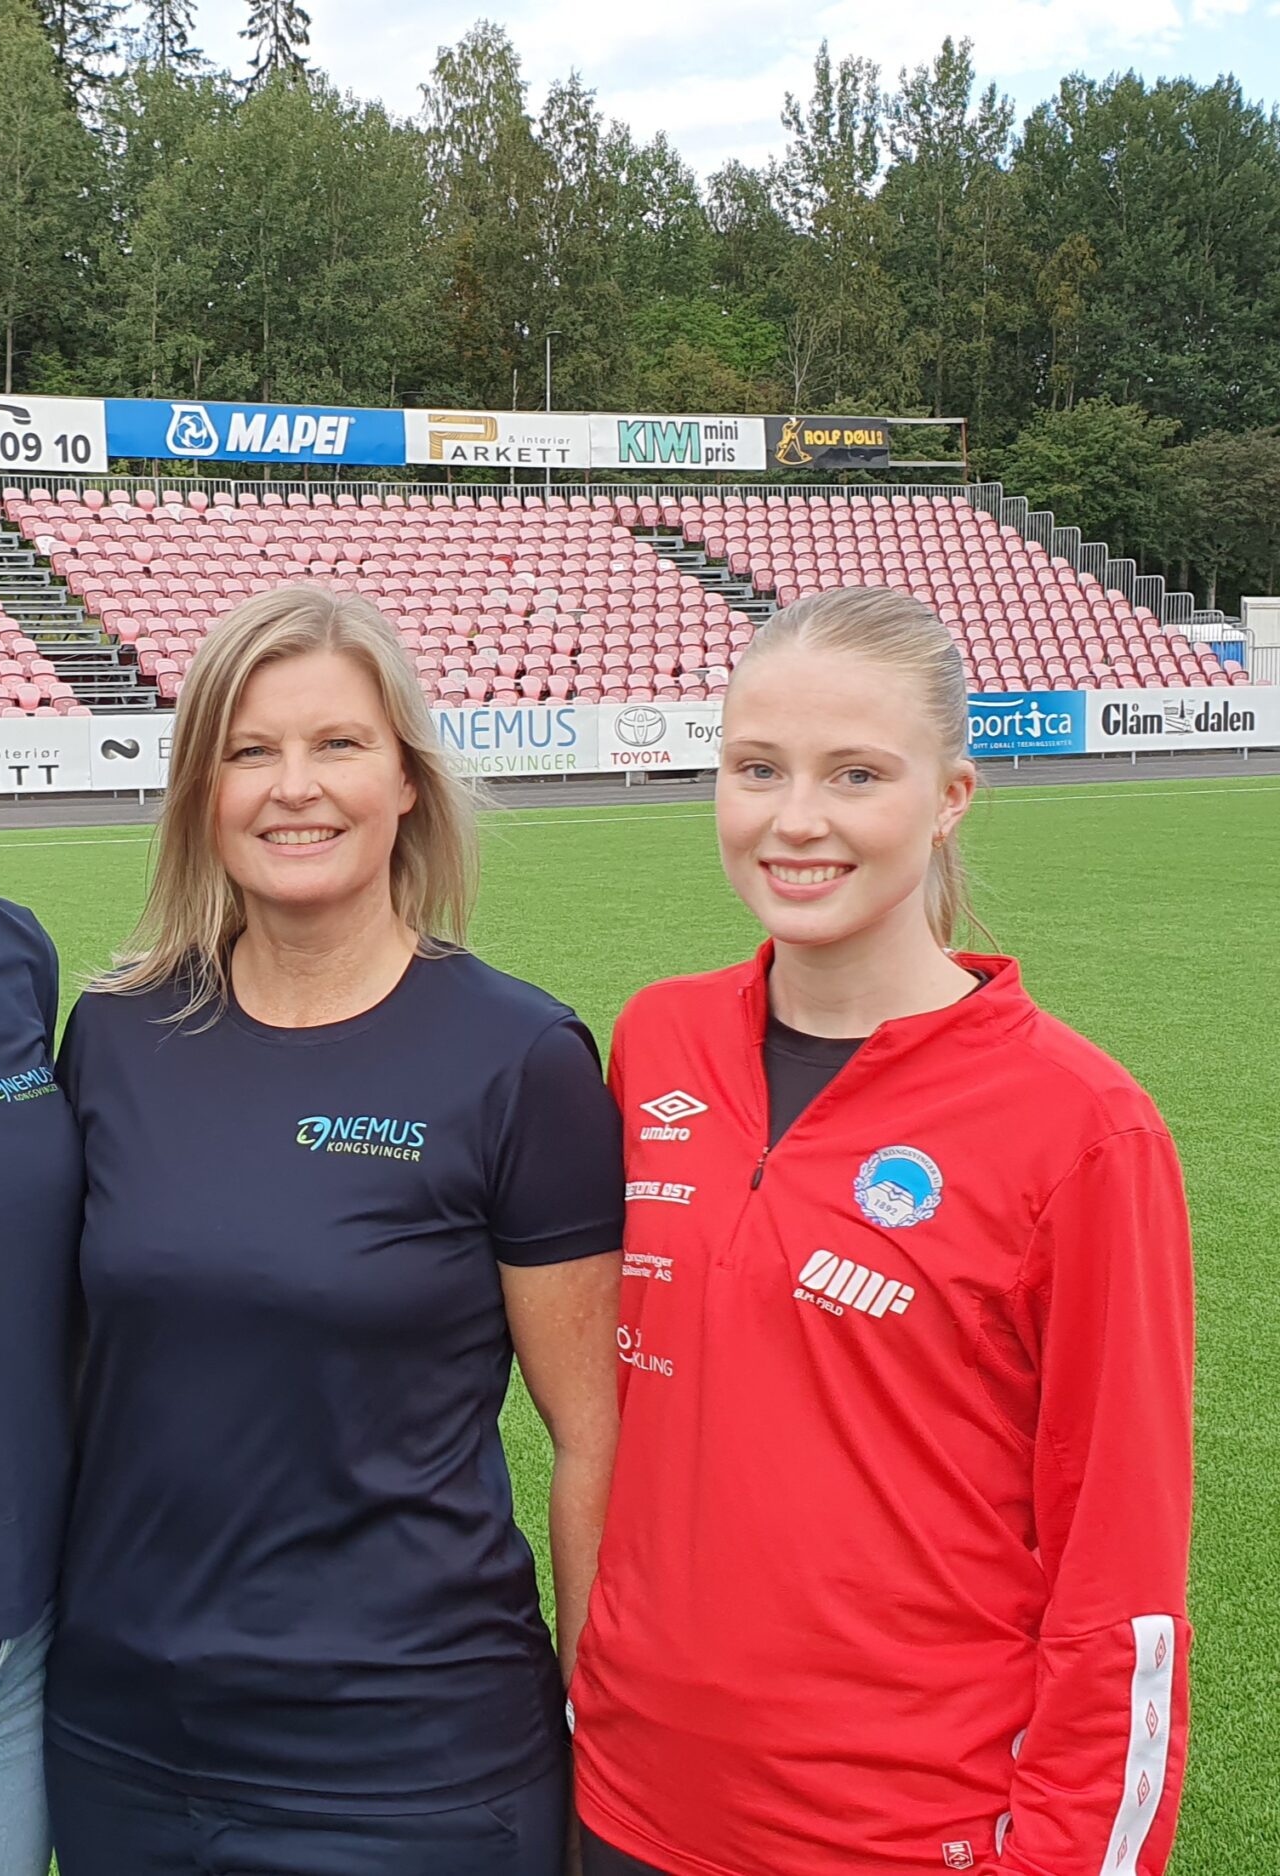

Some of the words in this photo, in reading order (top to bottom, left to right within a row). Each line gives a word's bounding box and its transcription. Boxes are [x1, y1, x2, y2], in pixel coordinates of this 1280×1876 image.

[224, 412, 350, 455] MAPEI
[521, 435, 572, 445] interiør
[617, 419, 702, 463] KIWI
[704, 420, 739, 441] mini
[803, 429, 841, 447] ROLF
[0, 431, 42, 462] 09
[53, 433, 92, 464] 10
[705, 443, 736, 466] pris
[439, 708, 577, 750] NEMUS
[610, 750, 672, 765] TOYOTA
[0, 1066, 54, 1094] NEMUS
[330, 1116, 427, 1147] NEMUS
[640, 1123, 691, 1142] umbro
[326, 1141, 421, 1162] KONGSVINGER
[873, 1198, 899, 1217] 1892
[654, 1268, 673, 1282] AS
